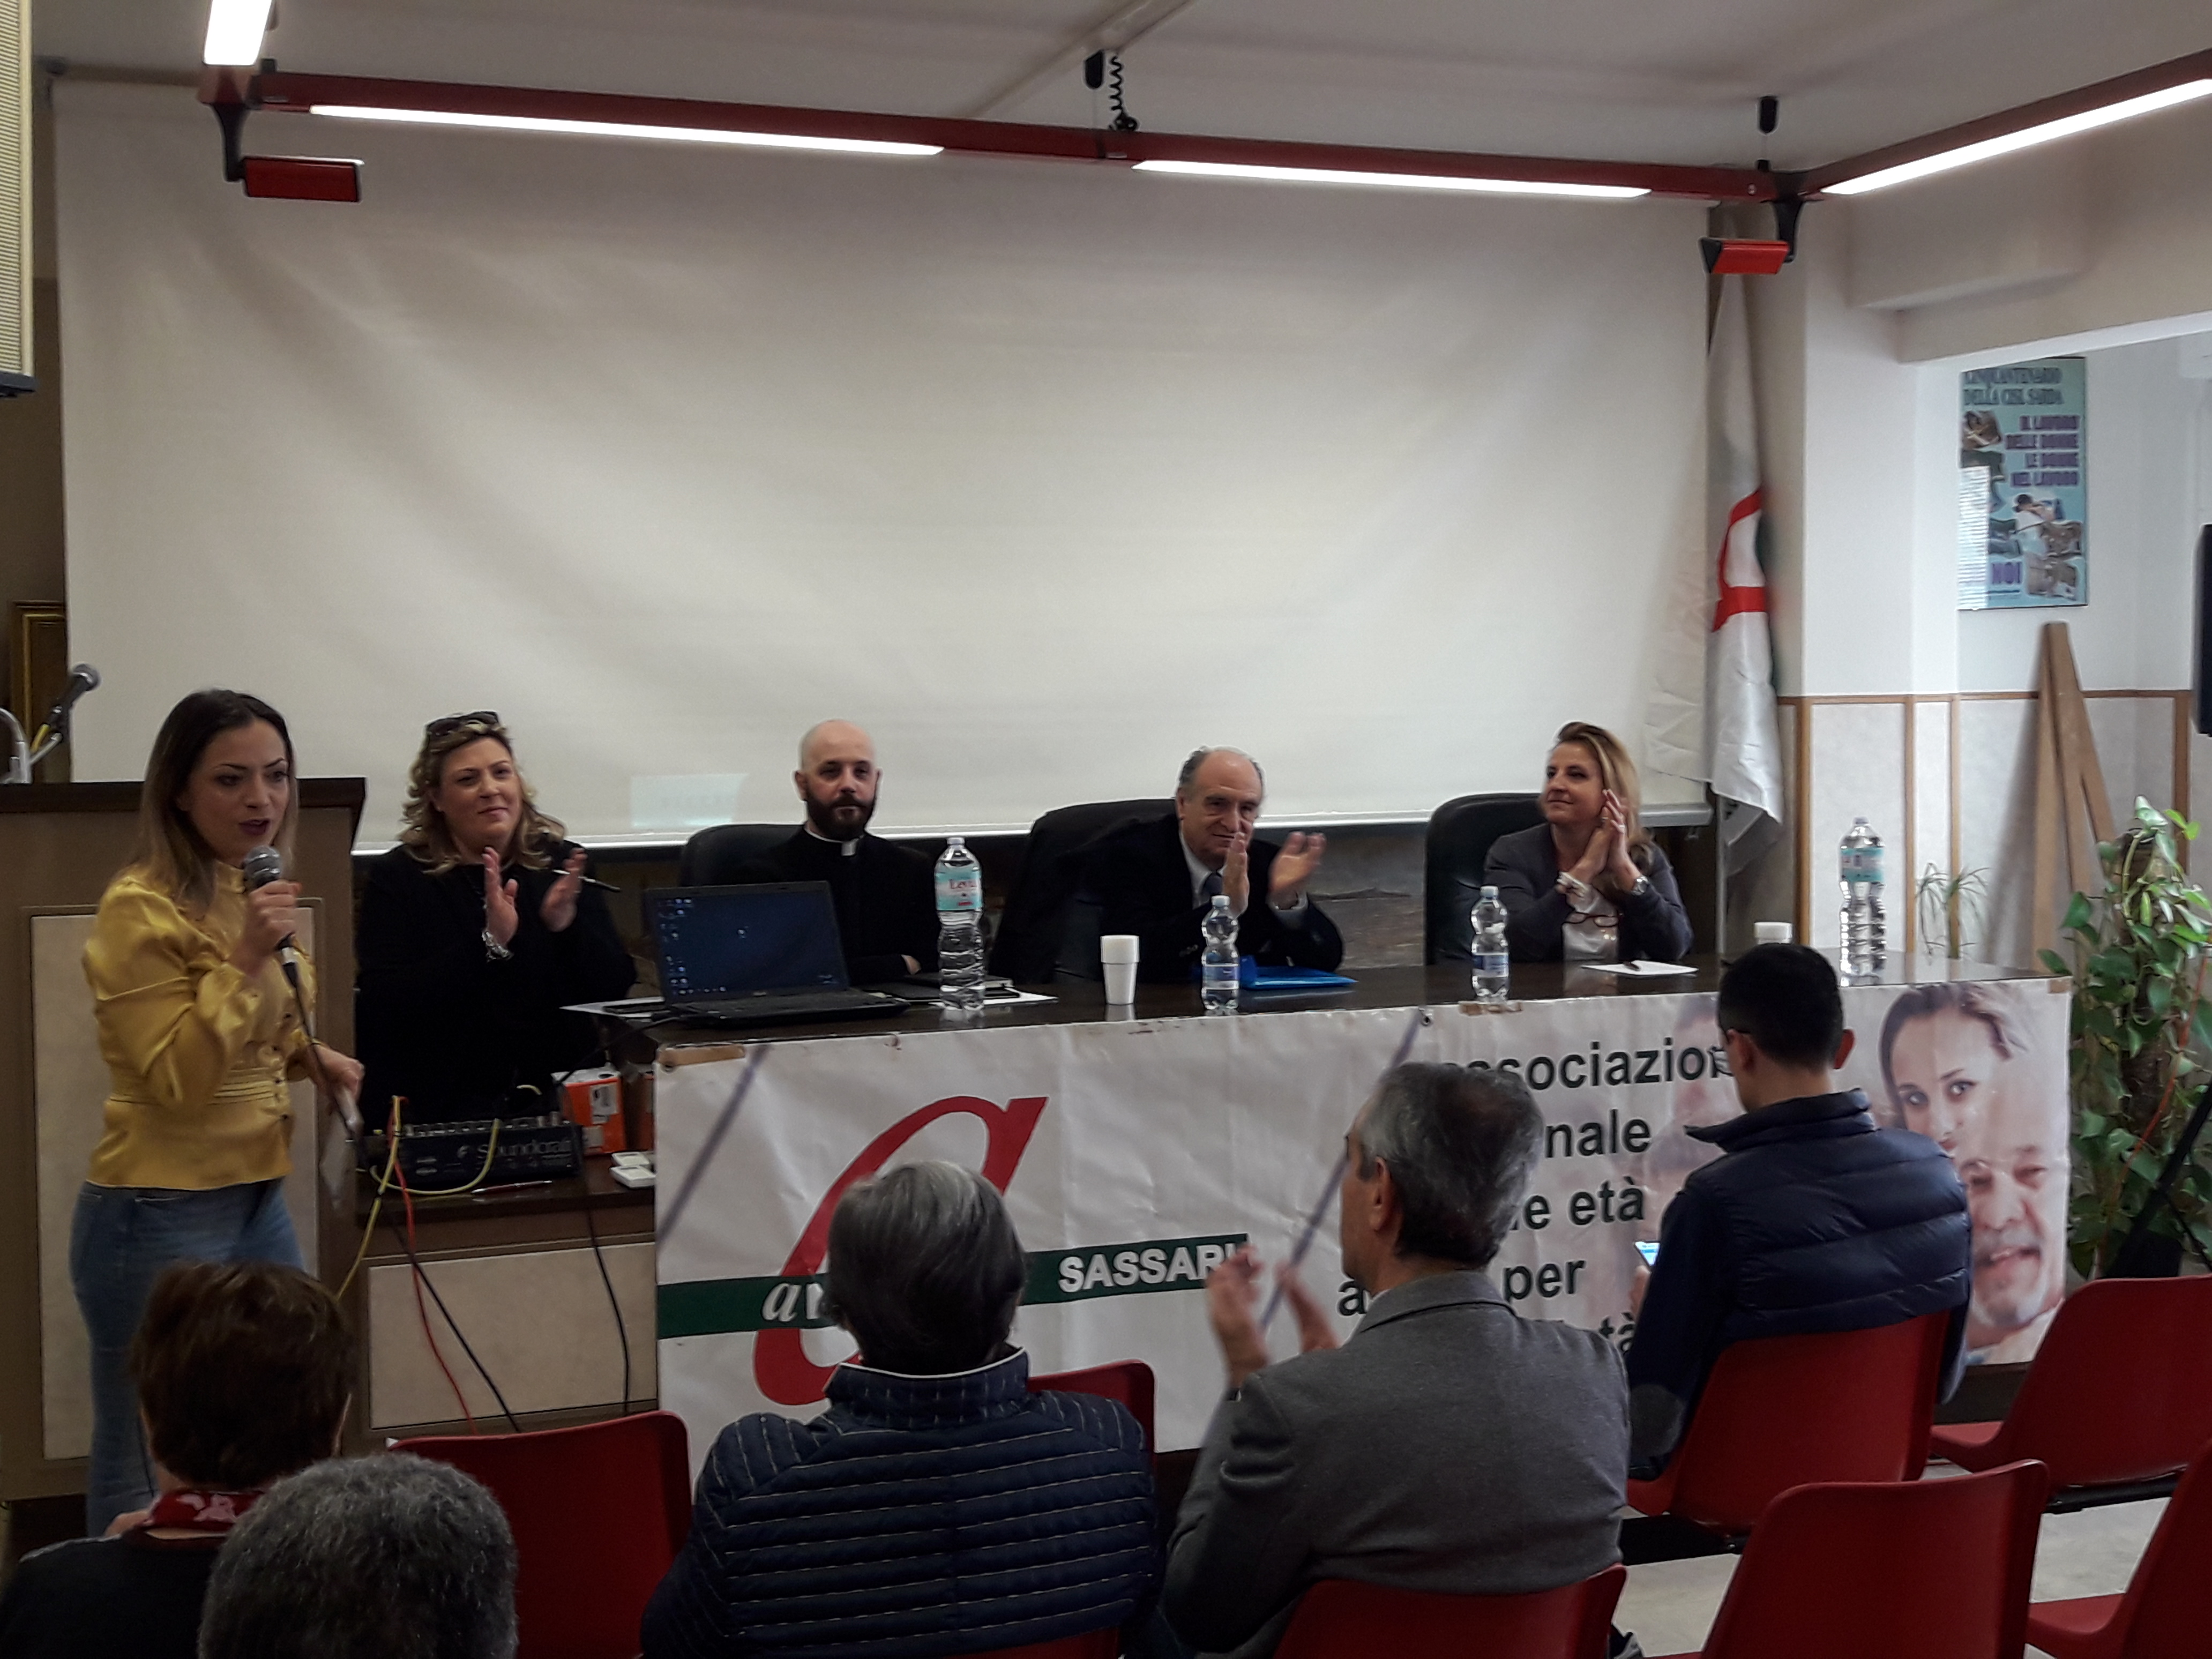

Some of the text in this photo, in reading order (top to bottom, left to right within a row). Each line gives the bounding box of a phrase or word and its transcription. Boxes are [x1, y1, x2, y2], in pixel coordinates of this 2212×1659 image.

[1545, 1109, 1651, 1159] nale
[1509, 1176, 1645, 1230] e età
[1503, 1260, 1586, 1304] per
